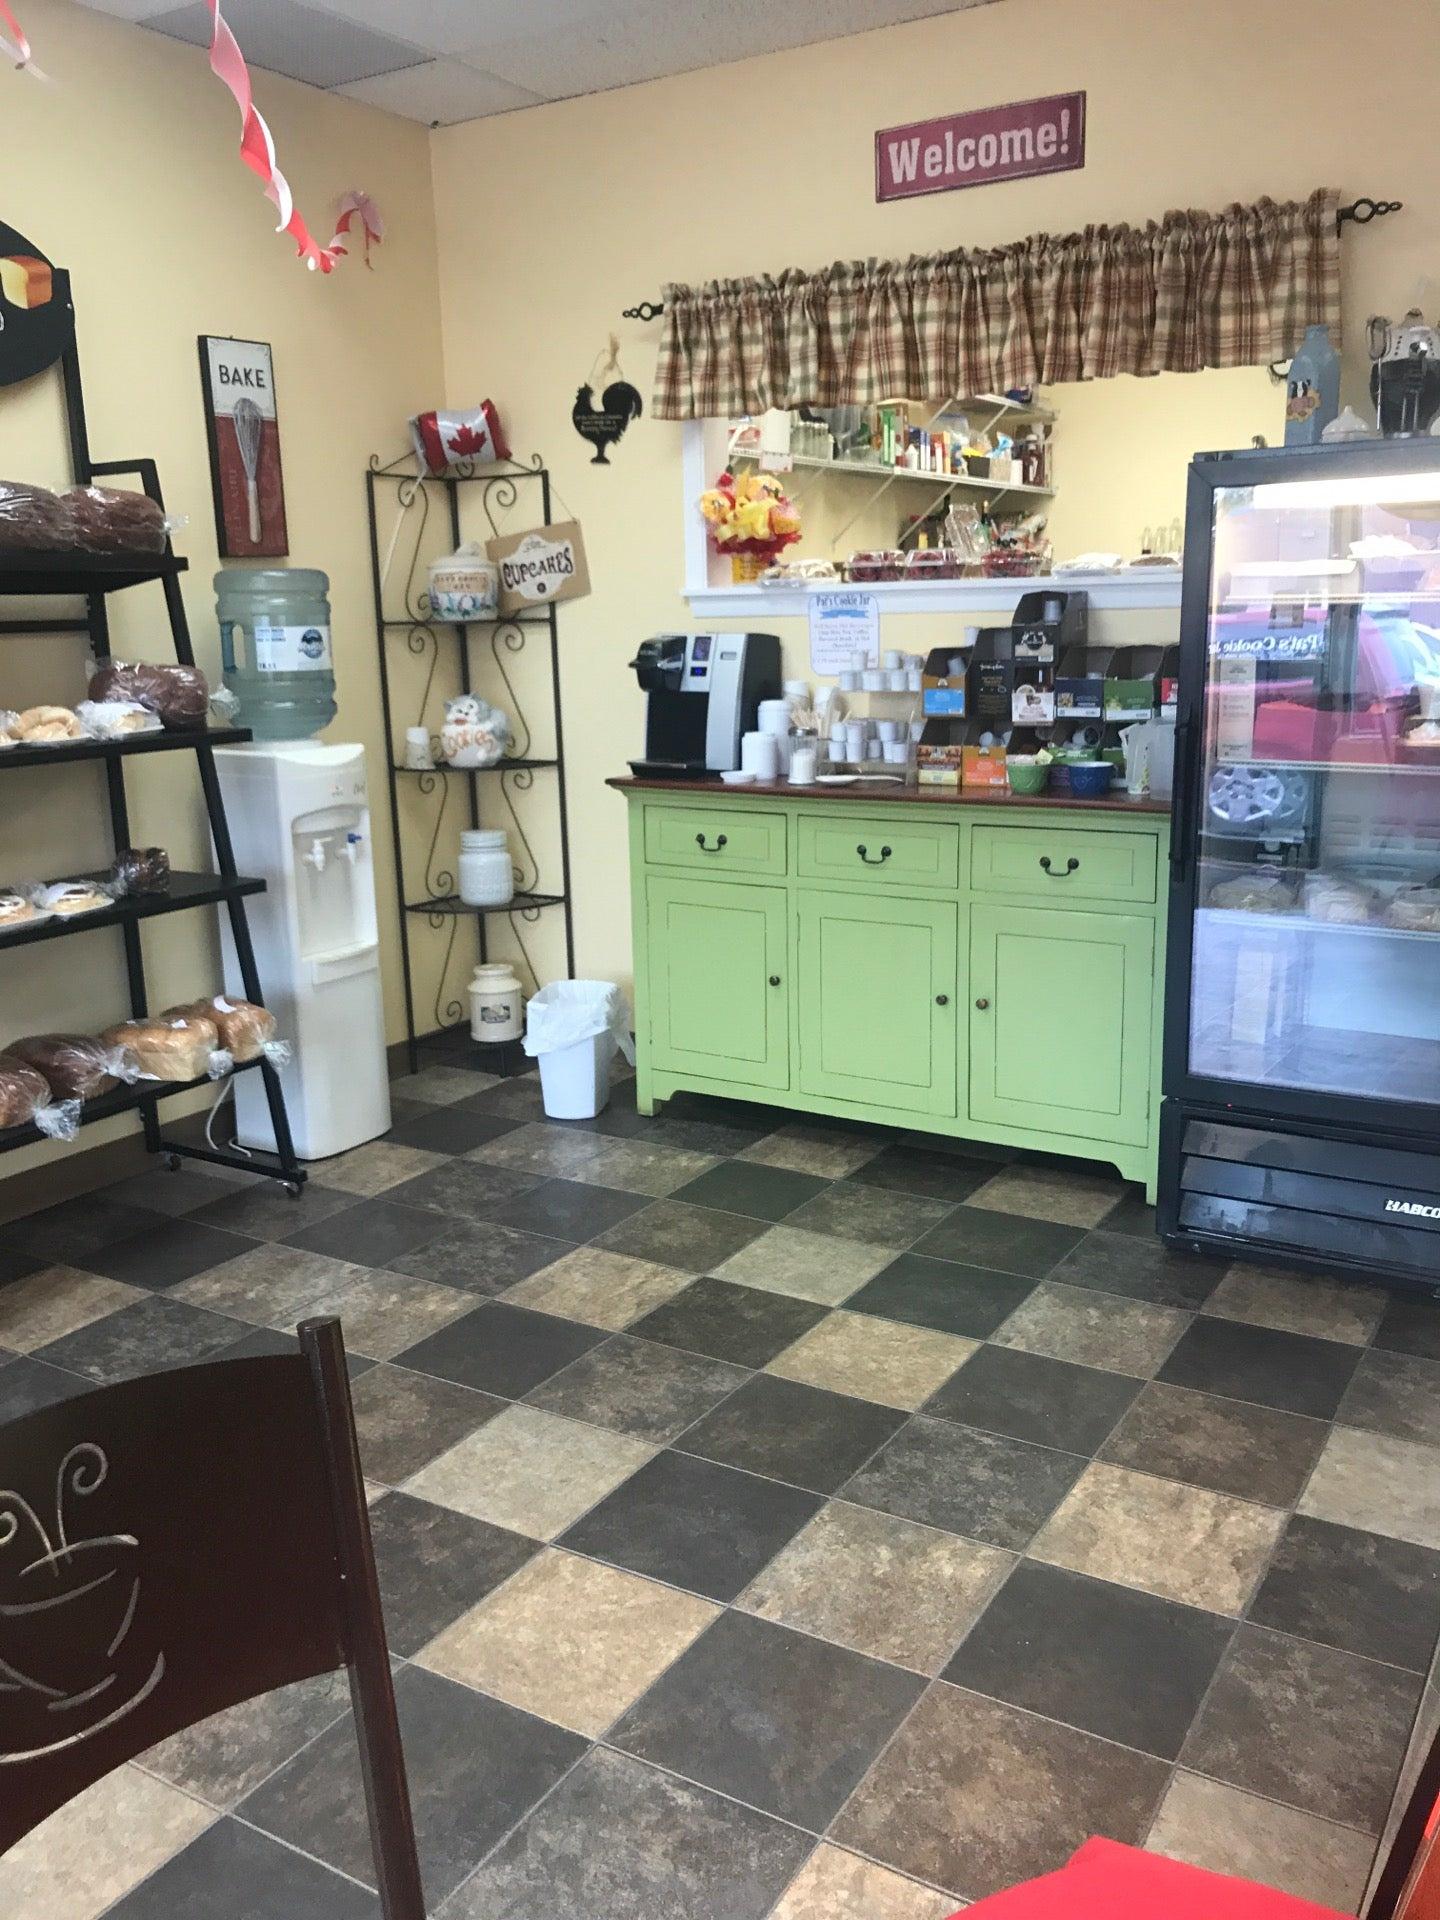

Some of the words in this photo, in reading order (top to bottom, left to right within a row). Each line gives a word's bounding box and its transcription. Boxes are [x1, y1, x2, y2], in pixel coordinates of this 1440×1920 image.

[888, 108, 1070, 184] Welcome!
[218, 364, 266, 388] BAKE
[502, 546, 573, 590] CUPCAKES
[1385, 1199, 1440, 1219] HABCO
